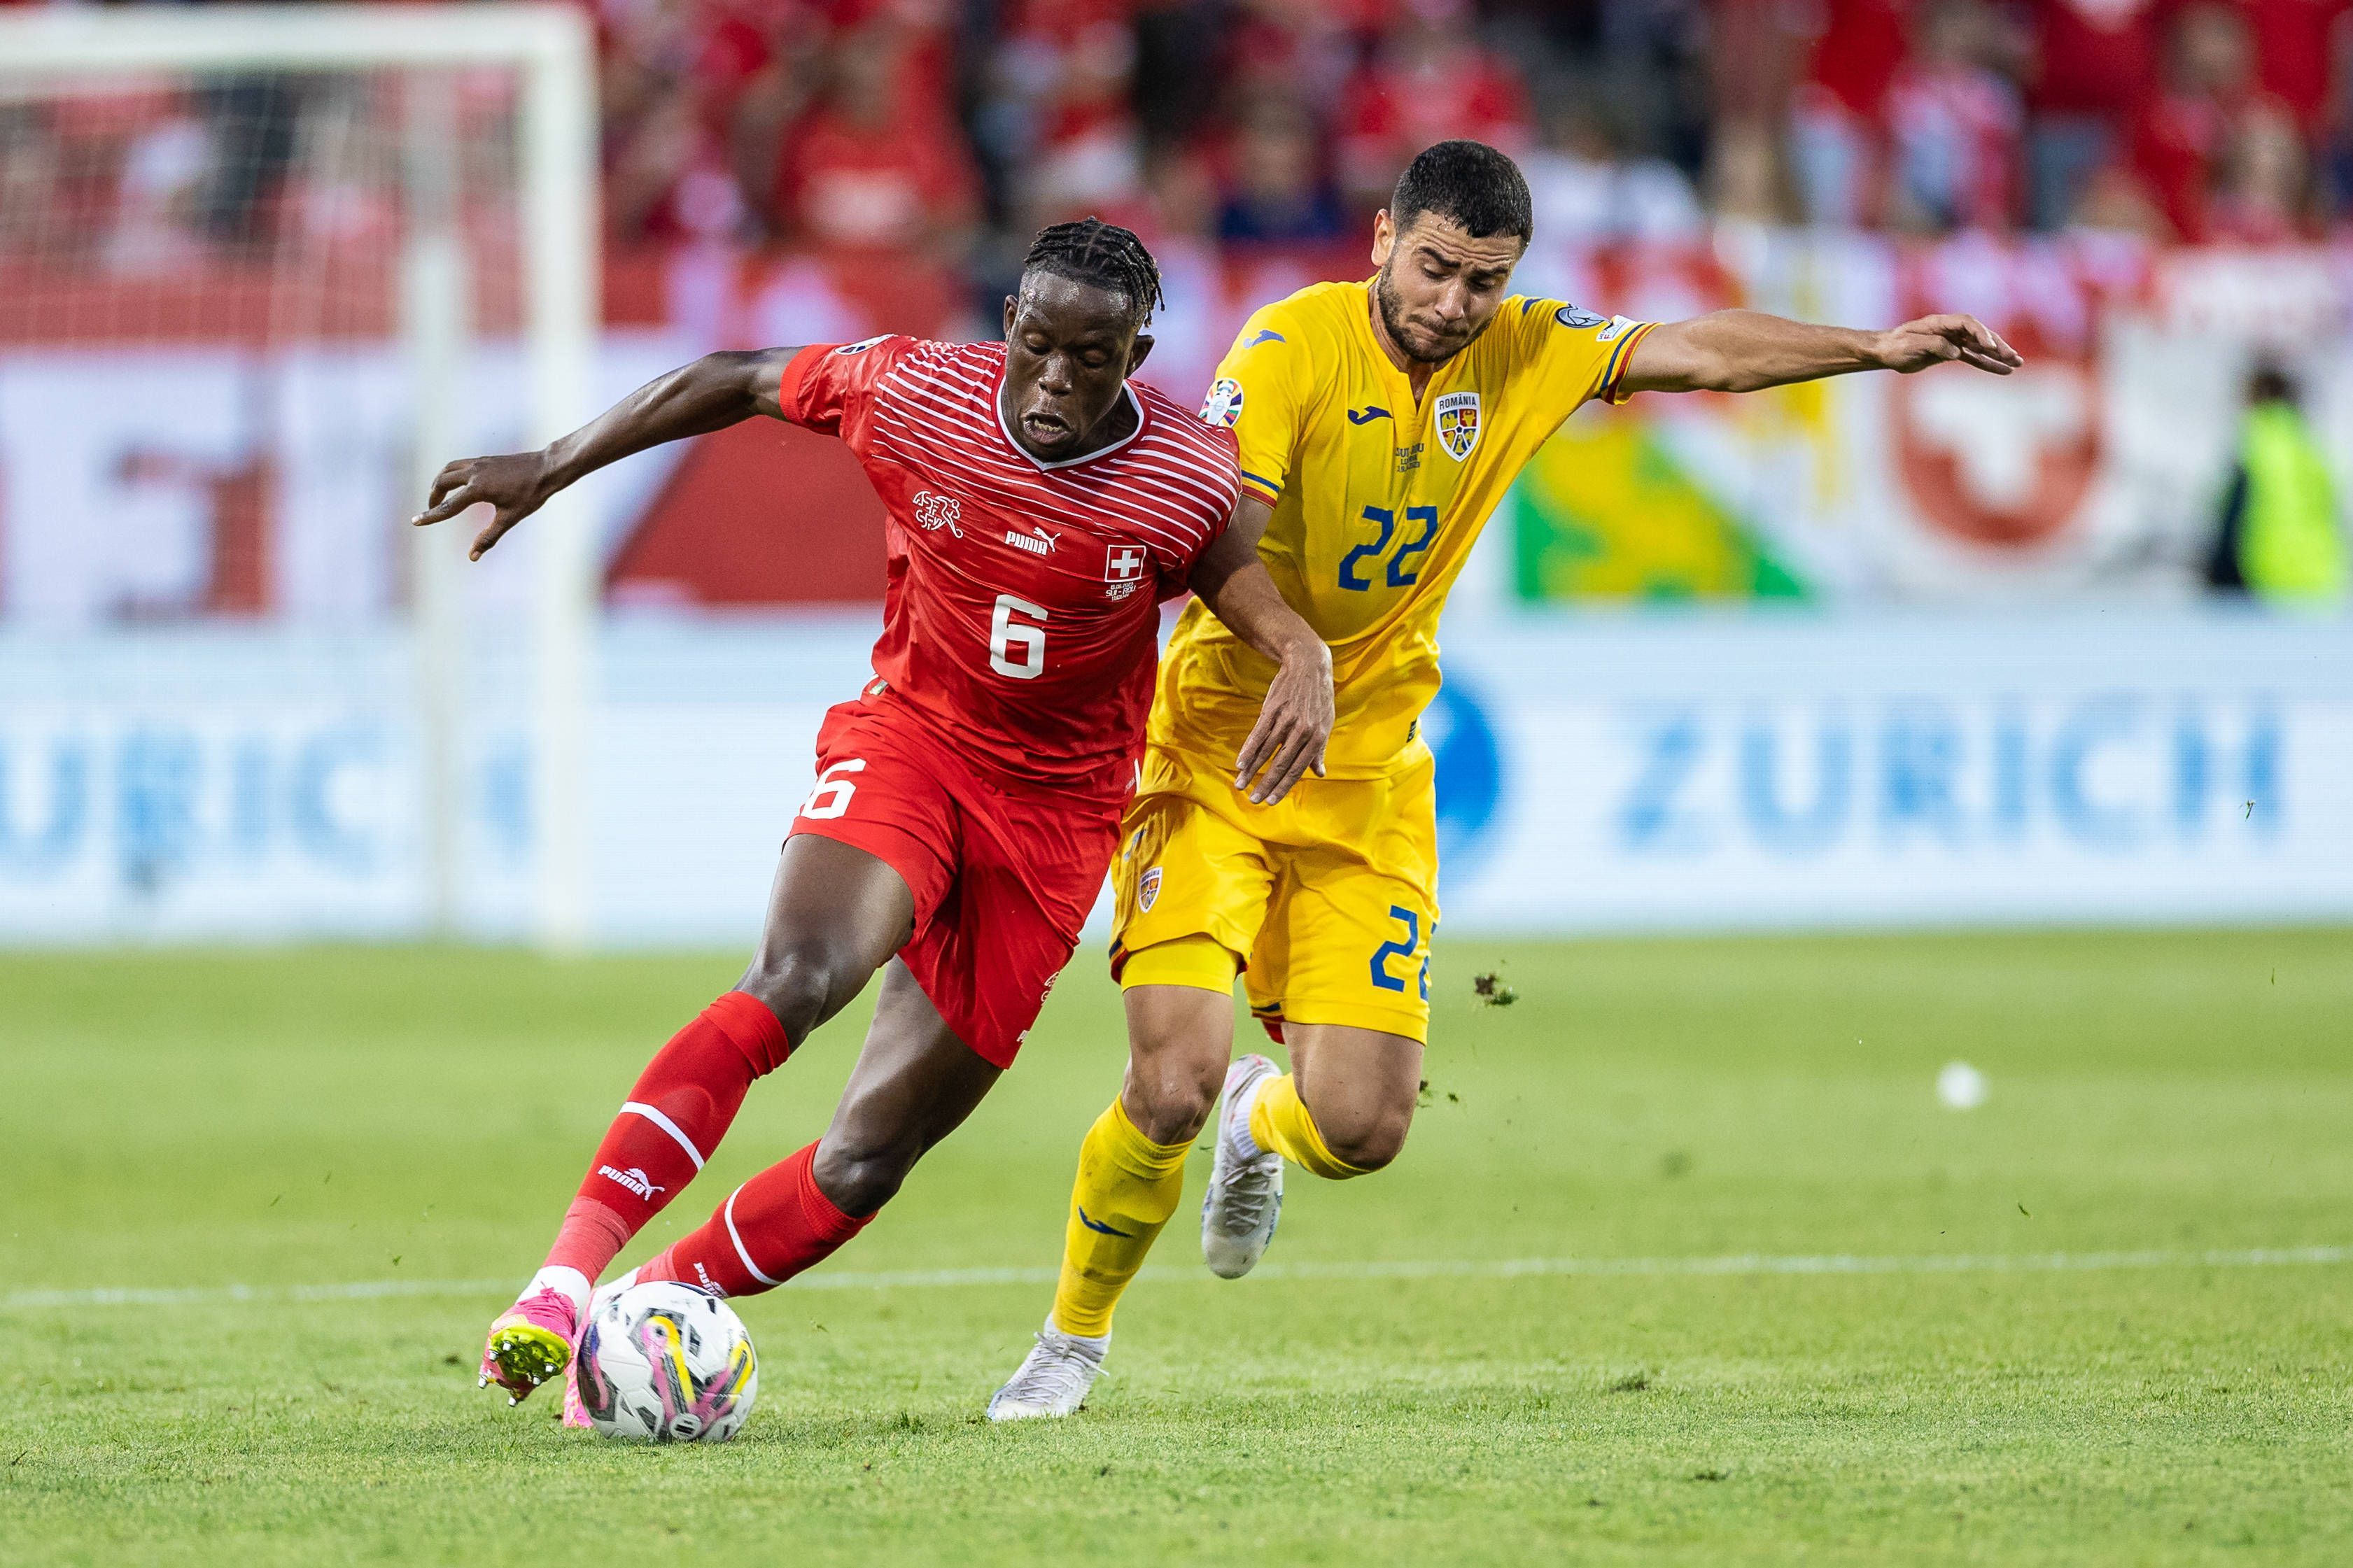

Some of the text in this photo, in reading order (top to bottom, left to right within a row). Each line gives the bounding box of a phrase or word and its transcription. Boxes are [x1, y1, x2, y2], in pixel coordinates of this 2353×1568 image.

[1439, 394, 1477, 410] ROMÂNIA
[1005, 530, 1048, 556] PUMA
[1338, 505, 1438, 591] 22
[989, 594, 1048, 679] 6
[801, 758, 867, 819] 6
[1620, 697, 2283, 849] ZURICH
[598, 1164, 646, 1196] PUMA
